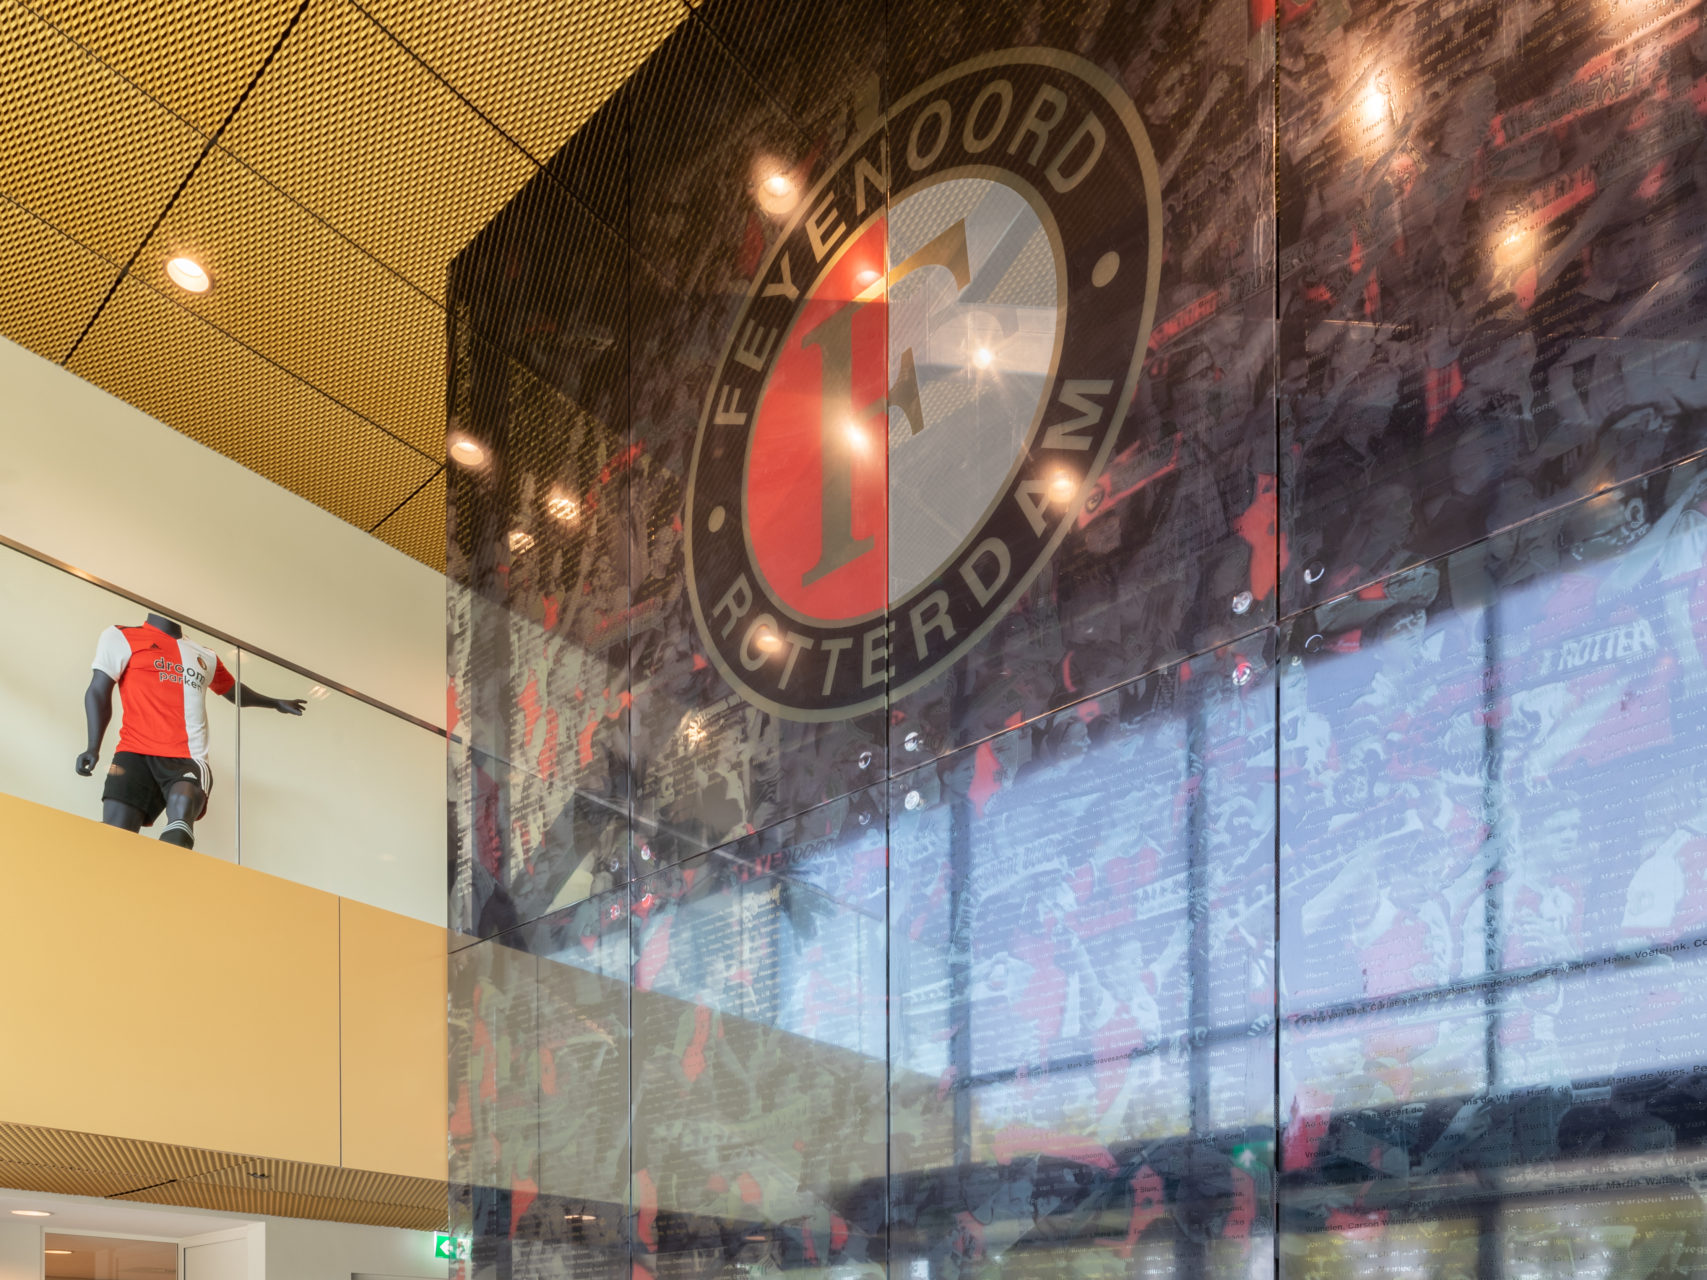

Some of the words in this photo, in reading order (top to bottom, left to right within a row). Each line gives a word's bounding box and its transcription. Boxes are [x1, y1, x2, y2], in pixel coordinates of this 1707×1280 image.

[713, 79, 1107, 427] FEYENOORD
[712, 378, 1115, 697] ROTTERDAM
[154, 657, 206, 686] droom
[159, 671, 202, 694] parken
[1640, 1073, 1654, 1082] de
